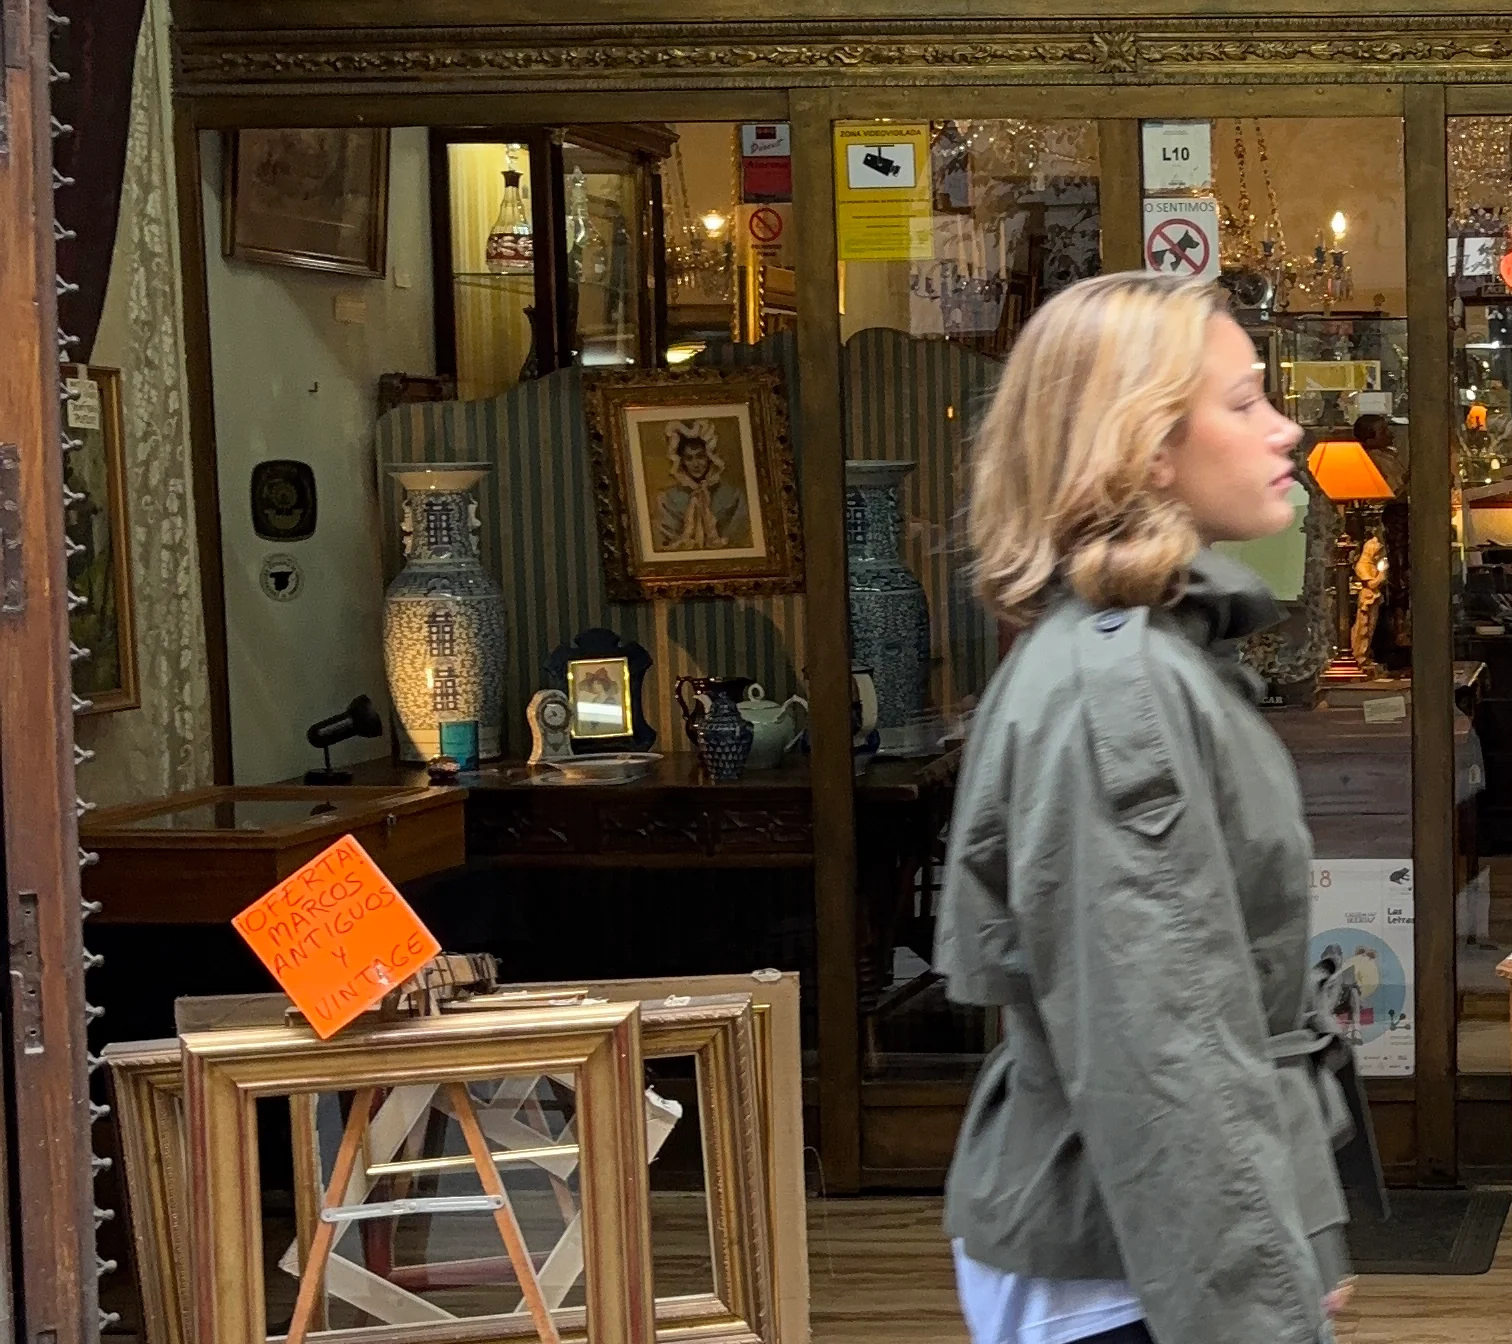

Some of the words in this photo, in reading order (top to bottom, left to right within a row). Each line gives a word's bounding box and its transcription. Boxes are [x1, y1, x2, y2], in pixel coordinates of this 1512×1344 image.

[840, 130, 861, 138] ZONA
[1162, 146, 1190, 161] L10
[1144, 203, 1154, 213] O
[1156, 201, 1215, 212] SENTIMOS
[268, 871, 364, 947] MARCOS
[271, 886, 396, 978] ANTIGUOS
[331, 946, 348, 968] Y
[315, 931, 424, 1021] VINTAGE
